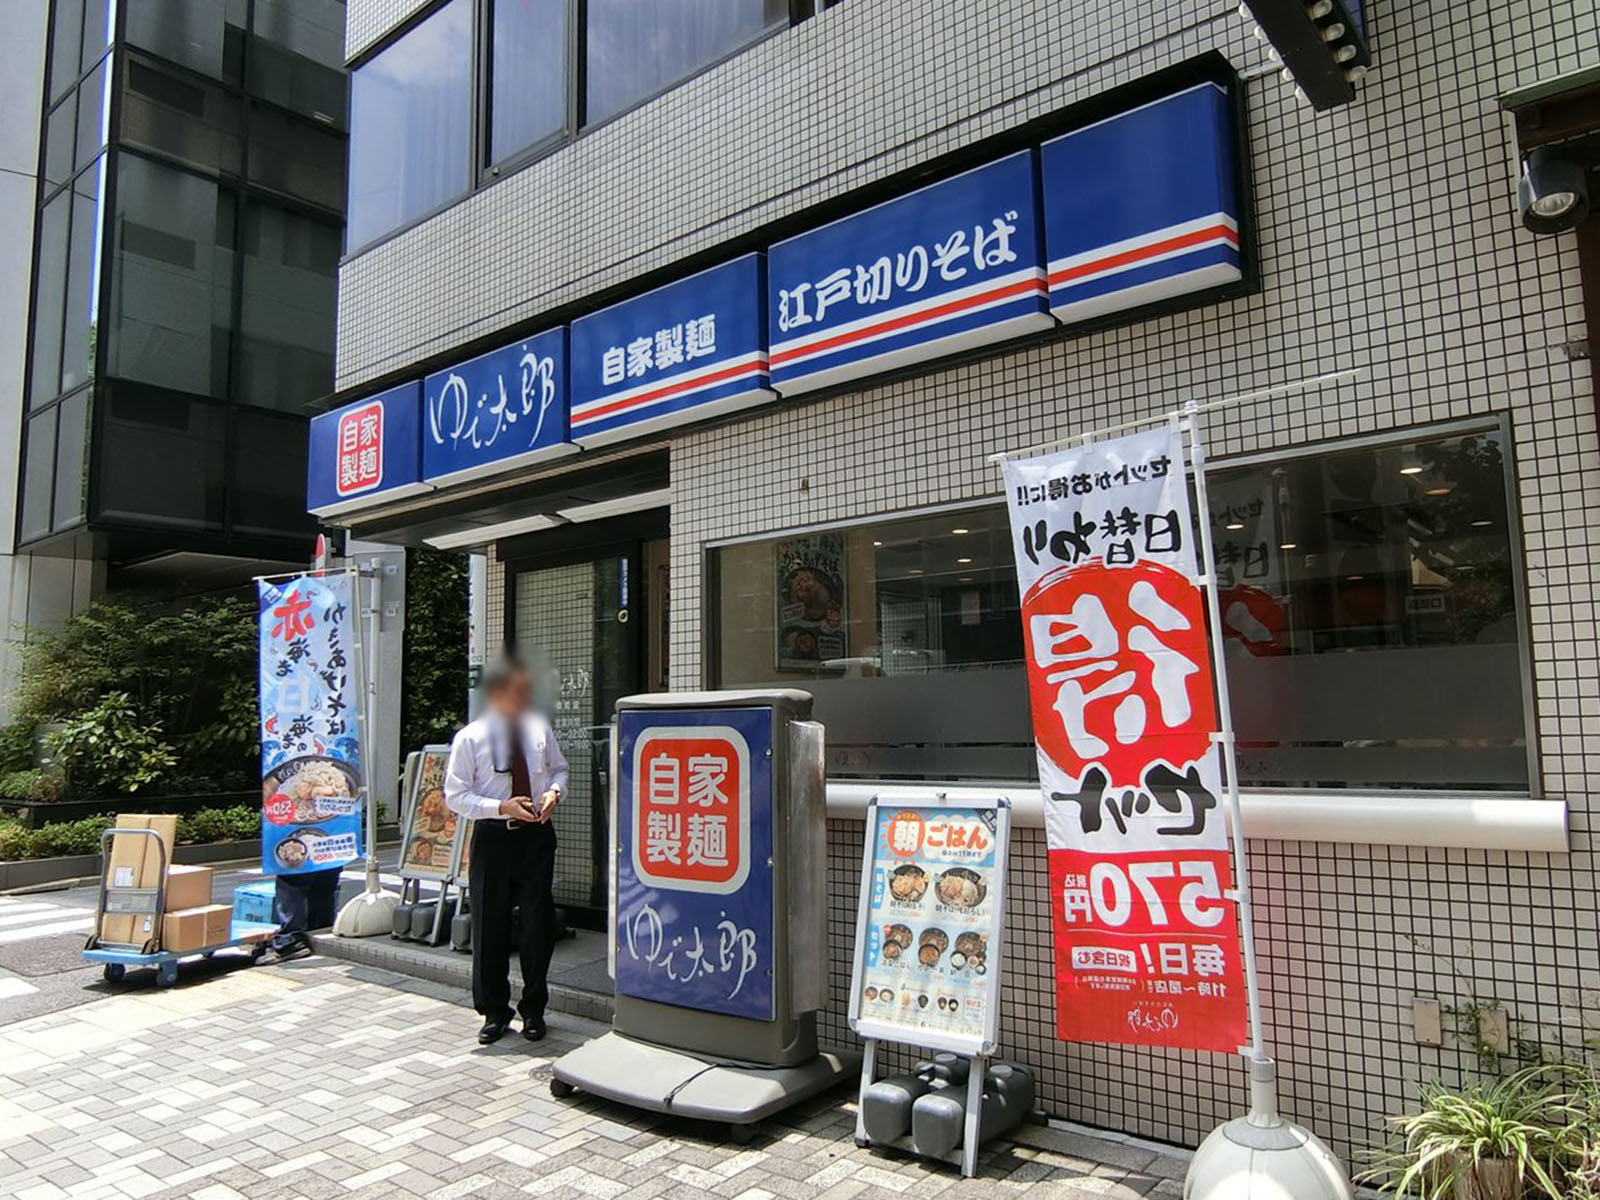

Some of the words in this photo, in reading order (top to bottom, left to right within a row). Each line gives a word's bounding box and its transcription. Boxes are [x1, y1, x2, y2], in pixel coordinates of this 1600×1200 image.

[778, 209, 1019, 332] 江戸切りそば
[602, 313, 716, 386] 自家製麺
[430, 344, 556, 450] ゆで太郎
[343, 413, 379, 452] 自家
[341, 446, 378, 486] 製麺
[648, 752, 729, 806] 自家
[645, 810, 729, 867] 製麺
[626, 903, 757, 1000] ゆで太郎
